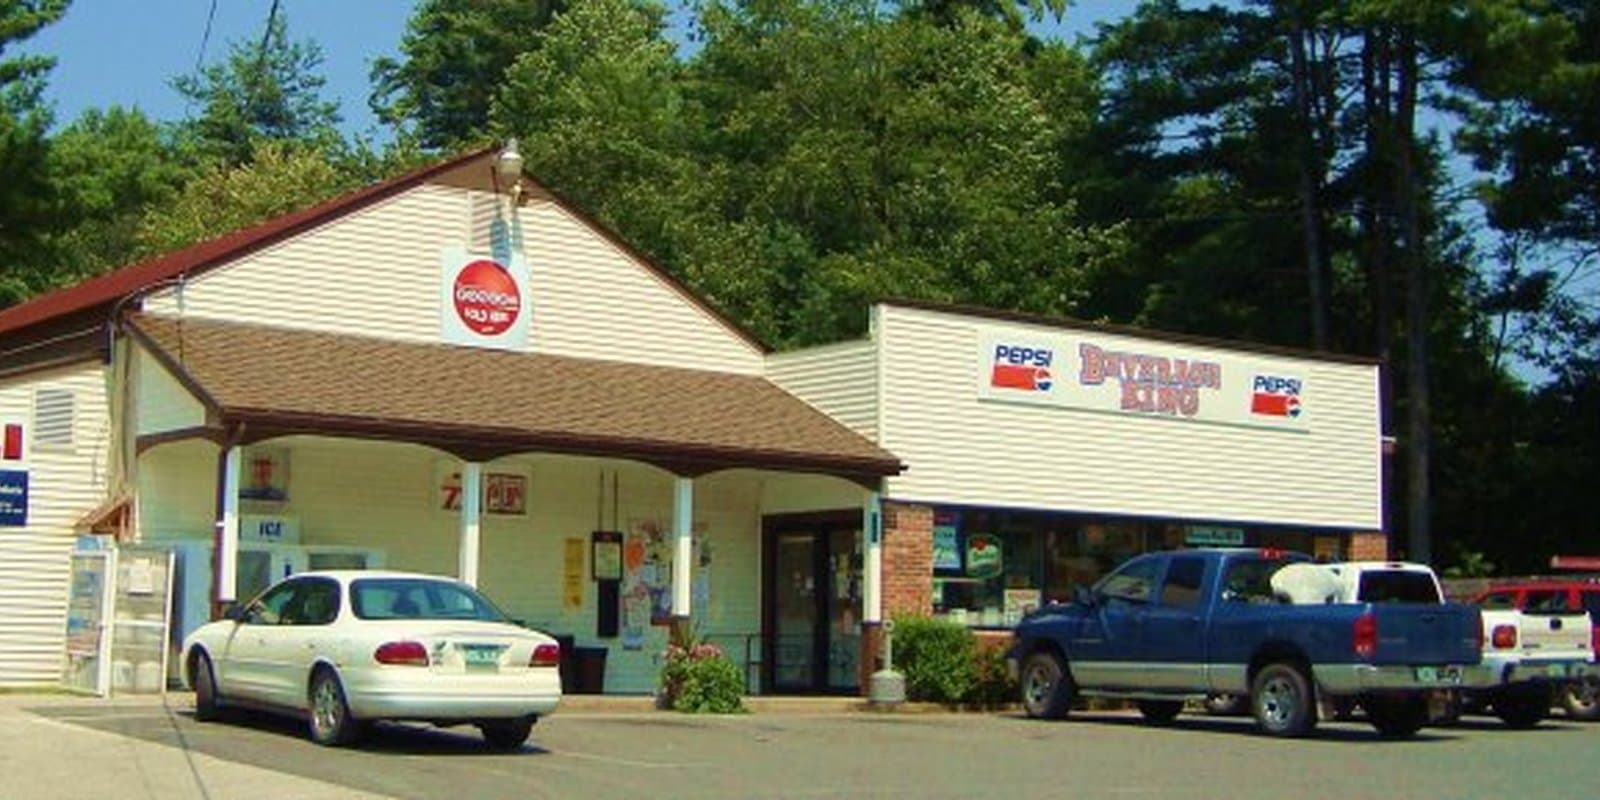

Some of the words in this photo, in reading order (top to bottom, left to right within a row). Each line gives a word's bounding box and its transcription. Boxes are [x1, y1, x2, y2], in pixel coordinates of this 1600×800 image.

[995, 345, 1053, 367] PEPSI
[1253, 375, 1302, 396] PEPSI
[259, 521, 282, 537] ICE
